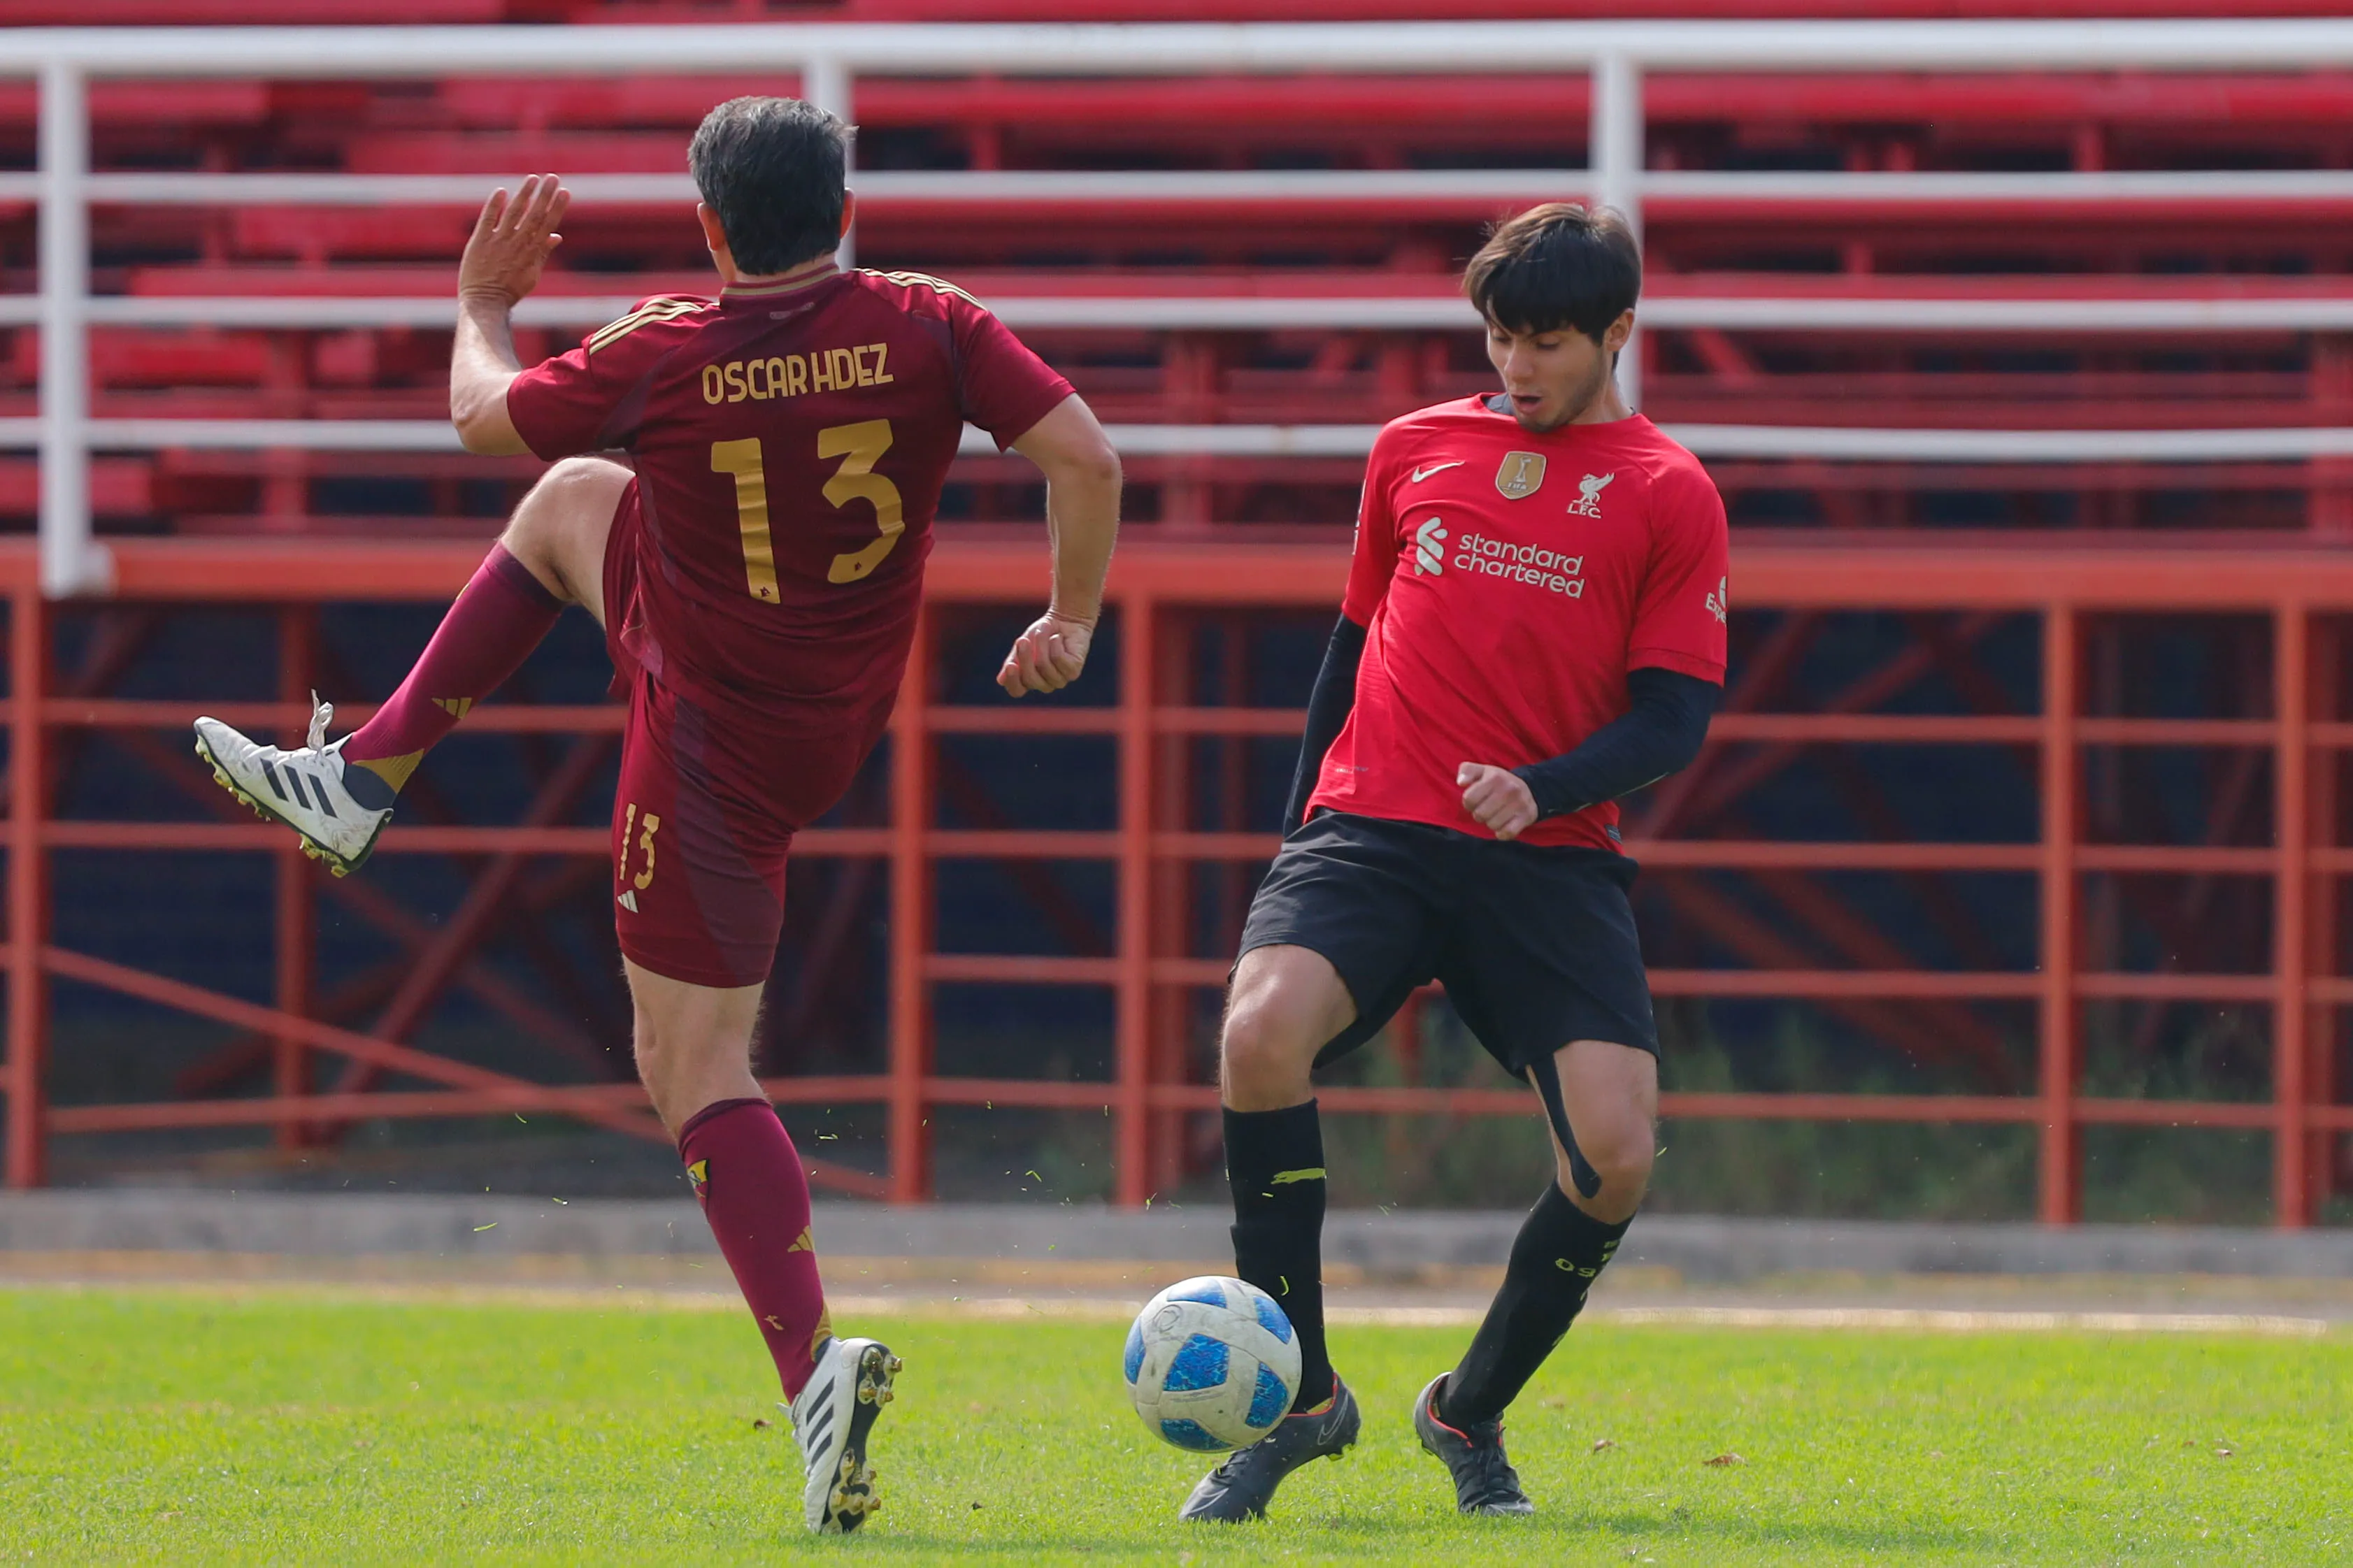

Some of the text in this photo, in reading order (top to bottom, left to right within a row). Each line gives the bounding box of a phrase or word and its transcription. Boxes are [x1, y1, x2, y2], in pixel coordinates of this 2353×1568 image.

[702, 343, 894, 405] OSCAR HDEZ
[711, 419, 905, 605] 13
[1566, 503, 1602, 519] LFC
[1454, 553, 1585, 598] chartered
[1459, 533, 1584, 575] standard
[620, 803, 660, 890] 13
